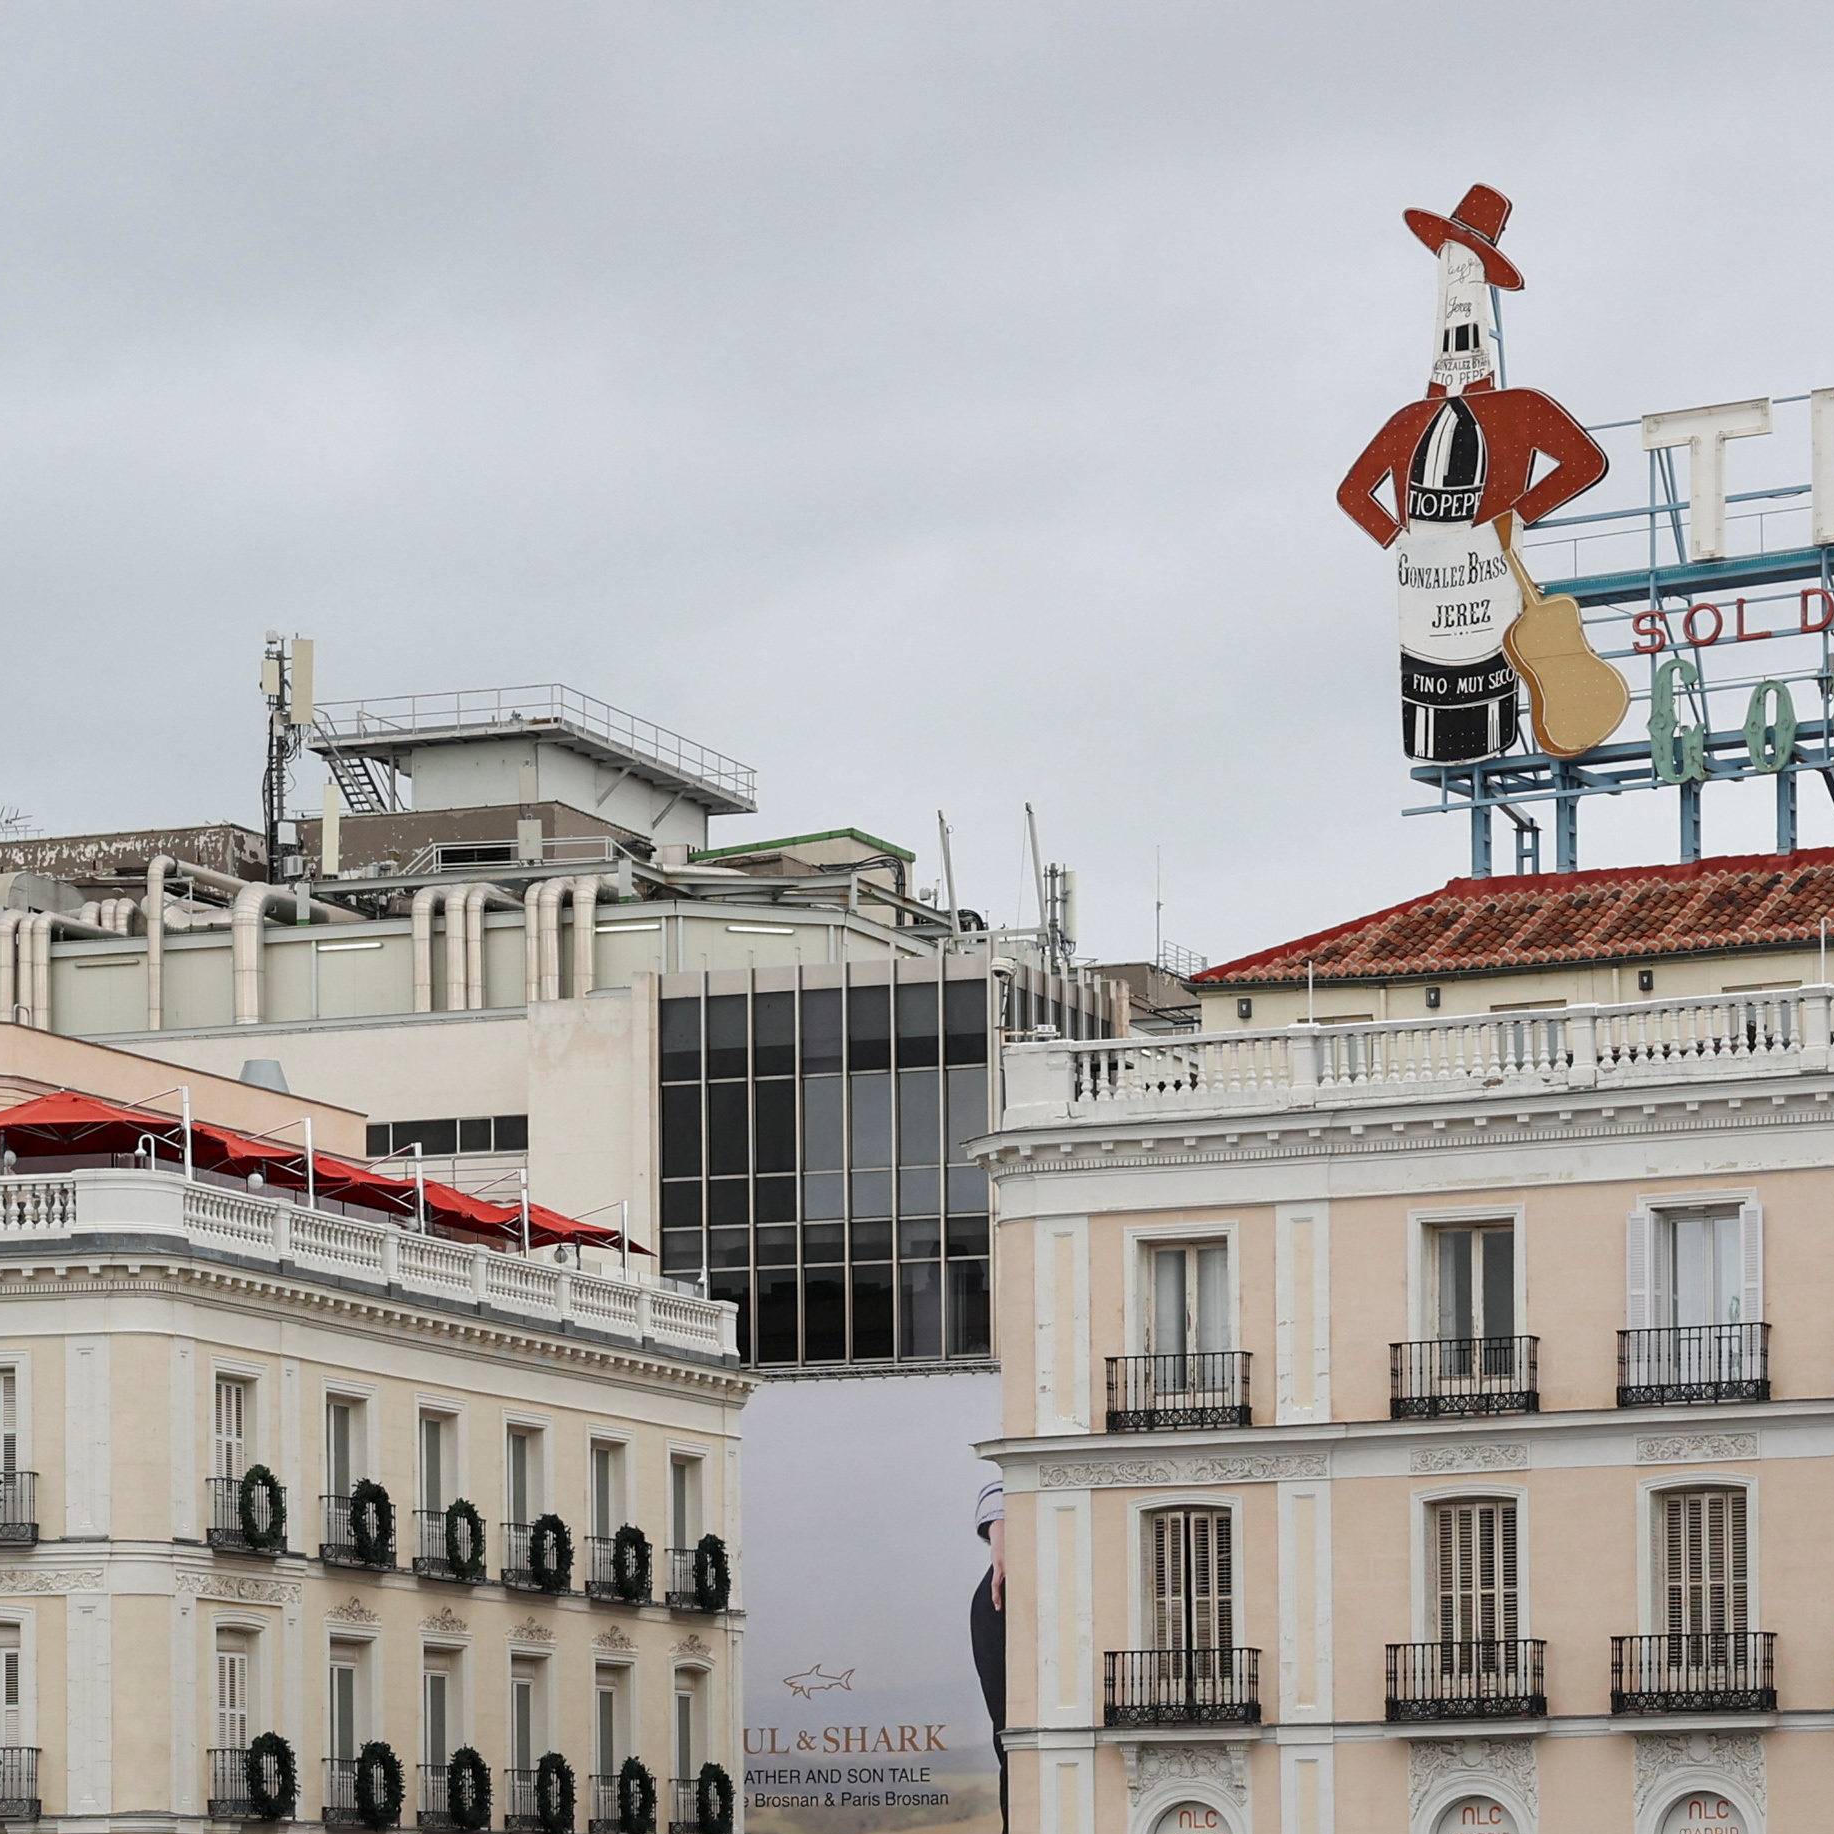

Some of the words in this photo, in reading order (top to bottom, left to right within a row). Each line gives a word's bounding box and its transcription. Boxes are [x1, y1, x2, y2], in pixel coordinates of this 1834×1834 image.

[1433, 370, 1454, 387] TIO
[1409, 490, 1438, 517] TIO
[1398, 553, 1465, 589] GONZALEZ
[1467, 551, 1507, 585] BYASS
[1432, 599, 1491, 629] JEREZ
[1632, 597, 1771, 654] SOL
[1413, 673, 1447, 694] FINO
[1456, 675, 1485, 695] MUY
[1488, 668, 1515, 690] SECO
[796, 1729, 817, 1751] &
[822, 1723, 949, 1754] SHARK
[744, 1768, 801, 1785] ATHER
[805, 1768, 842, 1784] AND
[847, 1768, 884, 1784] SON
[889, 1767, 930, 1784] TALE
[755, 1792, 818, 1808] Brosnan
[824, 1792, 835, 1807] &
[841, 1791, 880, 1807] Paris
[885, 1790, 949, 1806] Brosnan
[1689, 1800, 1730, 1820] NLC
[1179, 1810, 1218, 1829] NLC
[1462, 1806, 1502, 1826] NLC
